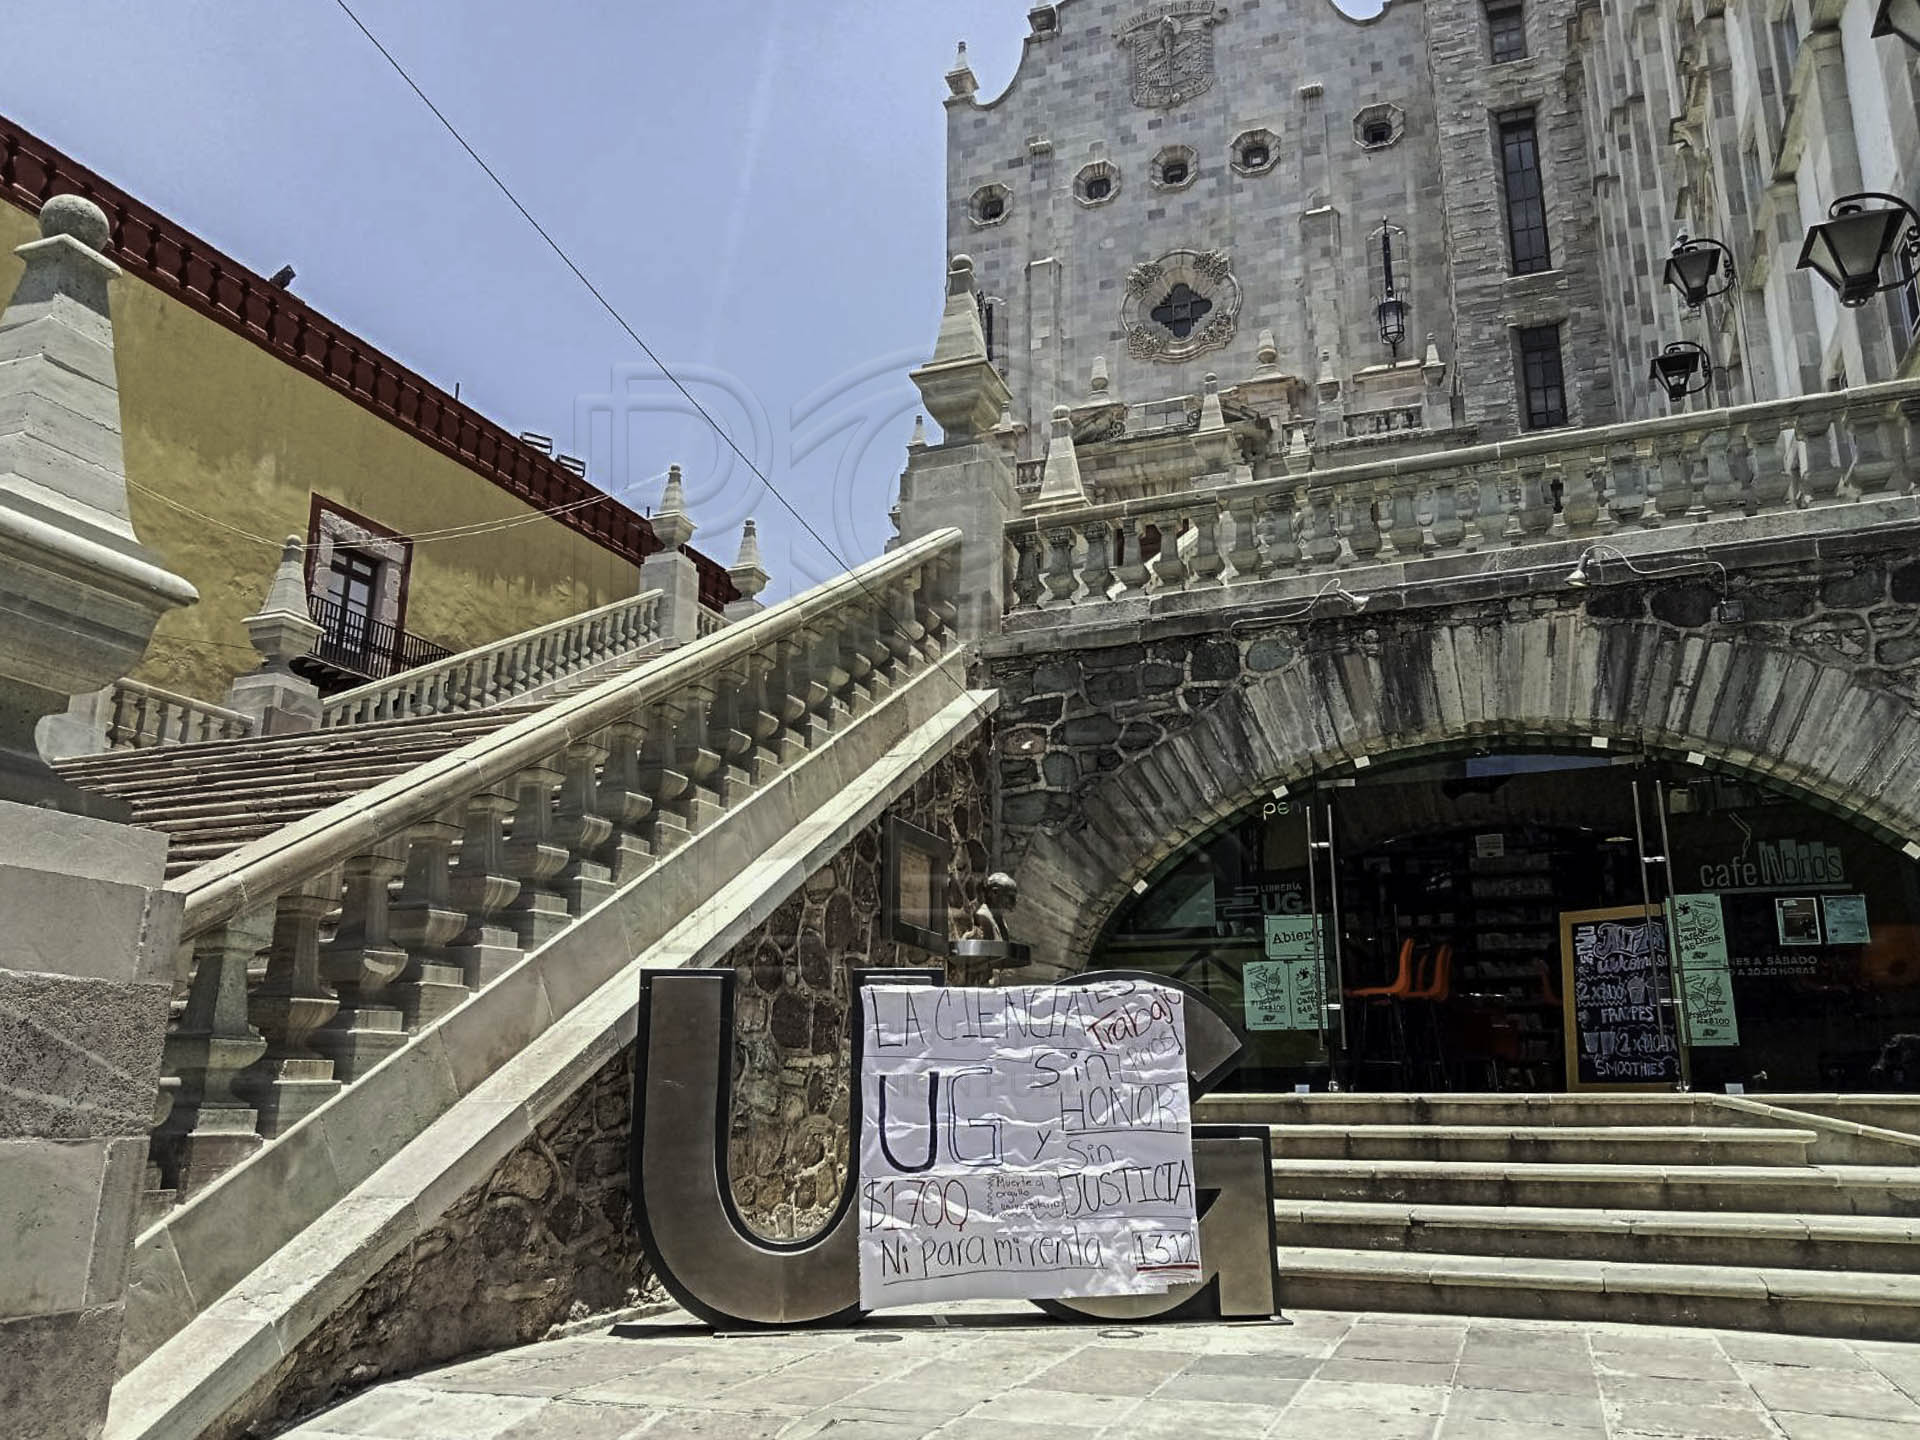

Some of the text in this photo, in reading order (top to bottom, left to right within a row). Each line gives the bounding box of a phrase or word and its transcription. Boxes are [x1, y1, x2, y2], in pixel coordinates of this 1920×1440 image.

[1261, 892, 1303, 914] UG
[1272, 929, 1324, 945] Abiero
[1779, 966, 1817, 975] HORAS
[869, 986, 925, 1049] LA
[935, 984, 1087, 1042] CIENCIA
[1594, 1060, 1666, 1077] SMOOTHIES
[878, 1066, 1004, 1174] UG
[1059, 1085, 1179, 1131] HONOR
[996, 1175, 1032, 1190] Muerte
[1058, 1159, 1194, 1217] JUSTICIA
[863, 1178, 970, 1233] $1700
[880, 1236, 910, 1278] Ni
[994, 1236, 1023, 1266] mi
[1029, 1225, 1105, 1268] renta
[1136, 1231, 1200, 1266] 1312
